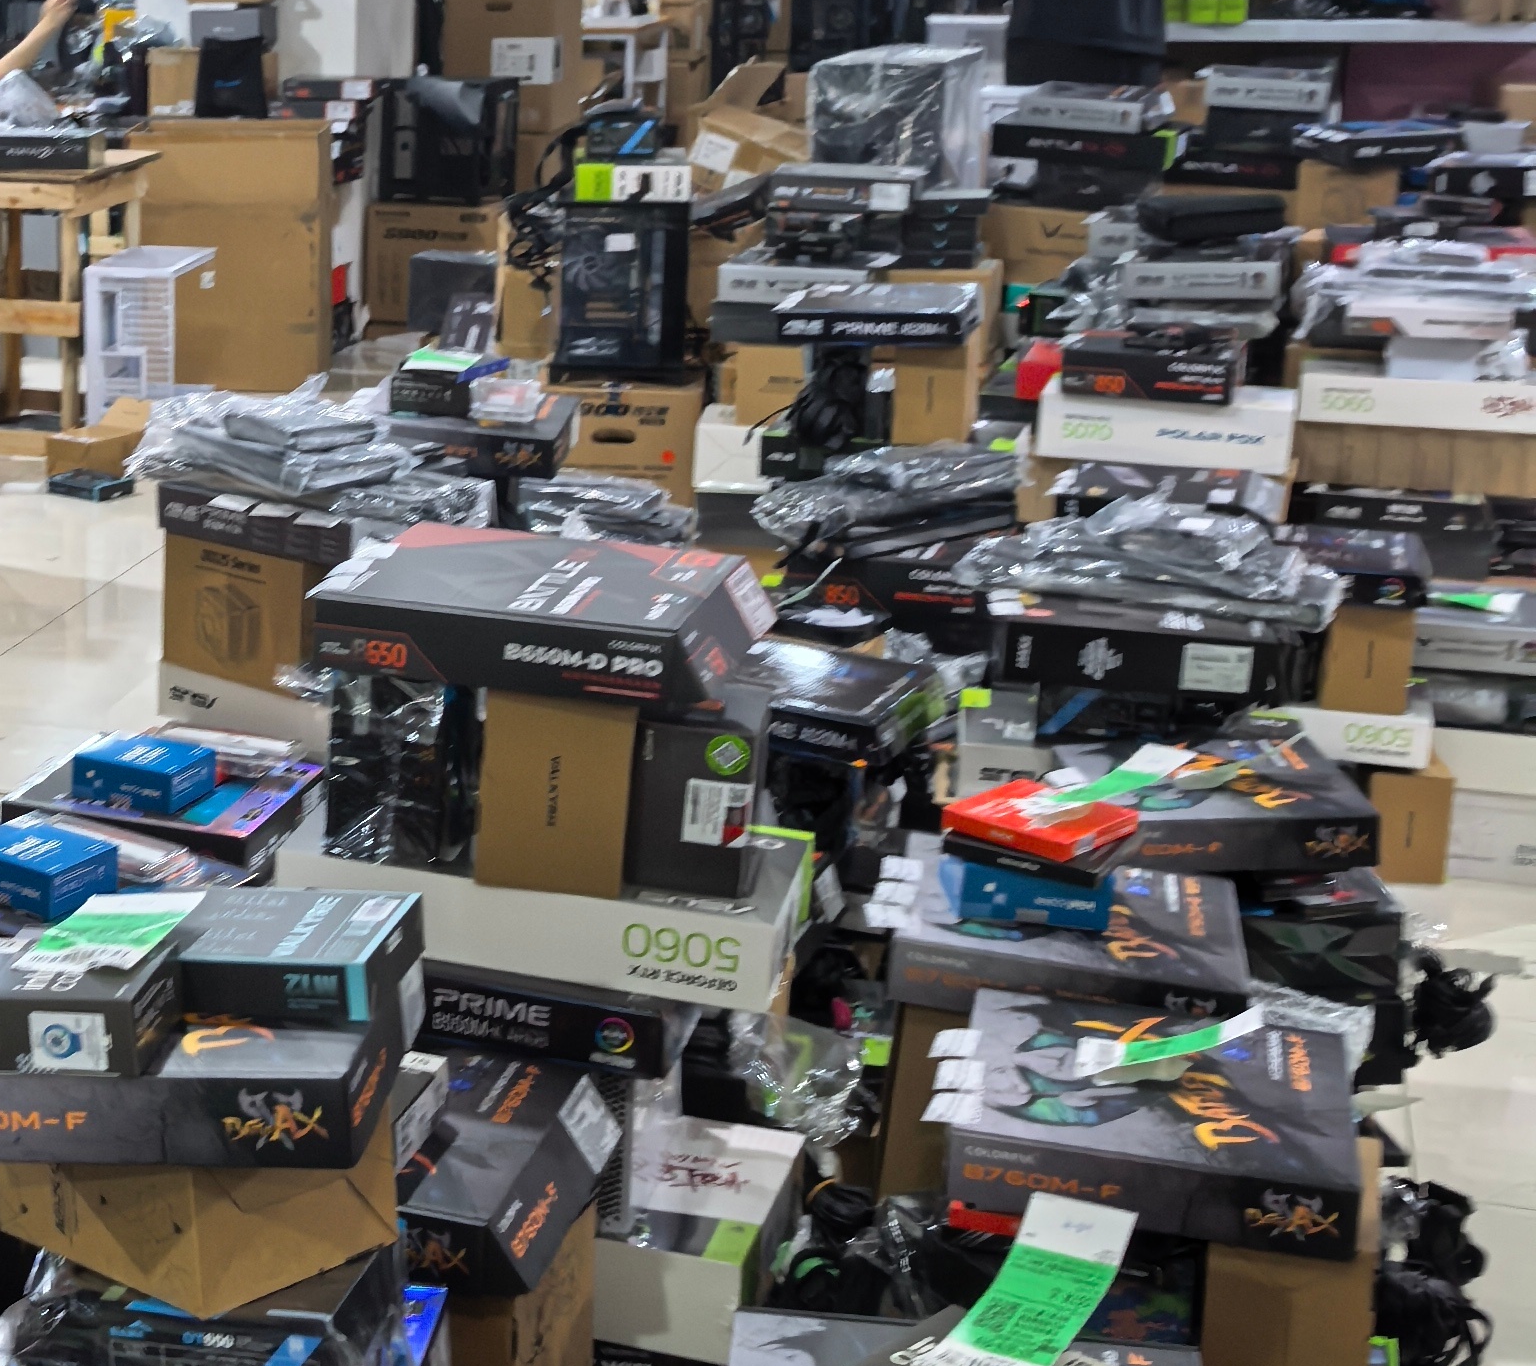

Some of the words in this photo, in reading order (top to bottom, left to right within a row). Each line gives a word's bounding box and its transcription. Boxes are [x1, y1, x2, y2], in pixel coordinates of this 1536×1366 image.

[622, 923, 741, 973] 5060
[432, 987, 553, 1028] PRIME
[963, 1162, 1124, 1200] B760M-F
